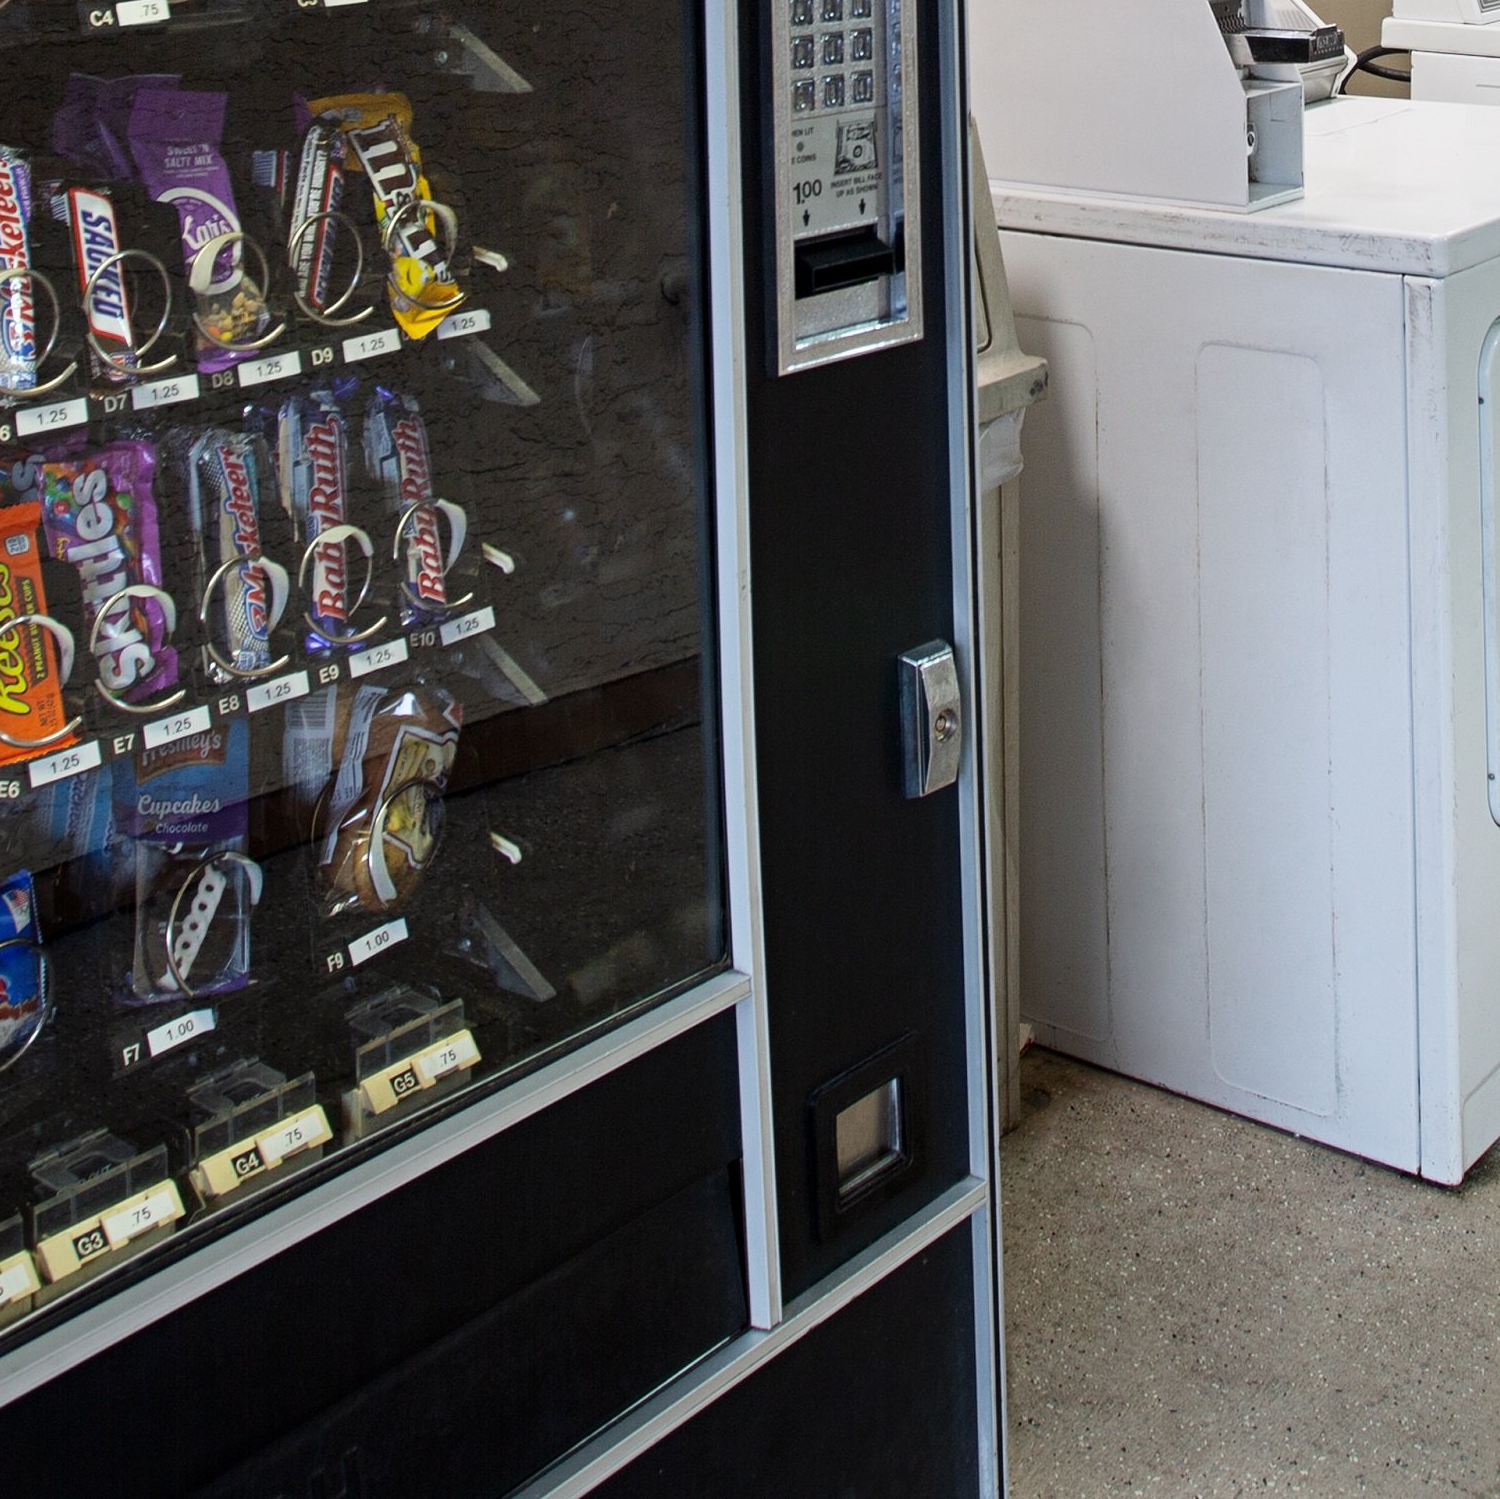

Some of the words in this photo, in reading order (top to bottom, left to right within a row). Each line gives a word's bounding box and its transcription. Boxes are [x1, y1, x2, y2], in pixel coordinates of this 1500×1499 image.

[89, 9, 115, 28] C4
[804, 126, 814, 136] LIT
[796, 153, 817, 164] COINS
[830, 177, 853, 190] INSERT
[853, 175, 866, 185] BILL
[867, 172, 883, 182] FACE
[835, 189, 845, 198] UP
[845, 187, 855, 197] AS
[855, 183, 878, 195] SHOWN
[450, 317, 477, 332] 1.25
[360, 337, 386, 353] 1.25
[311, 349, 334, 367] D9
[256, 360, 283, 377] 1.25
[211, 370, 235, 390] D8
[151, 384, 180, 400] 1.25
[104, 393, 127, 414] D7
[37, 408, 68, 426] 1.25
[304, 413, 344, 515] Ruth
[392, 412, 433, 502] Ruth
[67, 468, 155, 691] Skittles
[21, 579, 33, 606] CUPS
[26, 606, 40, 636] BUER
[456, 617, 480, 634] 1.25
[410, 632, 436, 647] E10
[31, 635, 45, 673] PEANUT
[365, 649, 392, 667] 1.25
[318, 666, 341, 684] E9
[265, 682, 292, 700] 1.25
[217, 696, 241, 715] E8
[163, 717, 192, 737] 1.25
[113, 735, 136, 753] E7
[51, 755, 80, 775] 1.25
[136, 794, 221, 819] Cupcakes
[154, 820, 209, 835] Chocolate
[365, 931, 390, 952] 1.00
[326, 952, 345, 973] F9
[166, 1019, 195, 1041] 1.00
[122, 1043, 141, 1066] F7
[393, 1071, 415, 1095] G5
[234, 1151, 260, 1175] G4
[76, 1232, 105, 1257] G3
